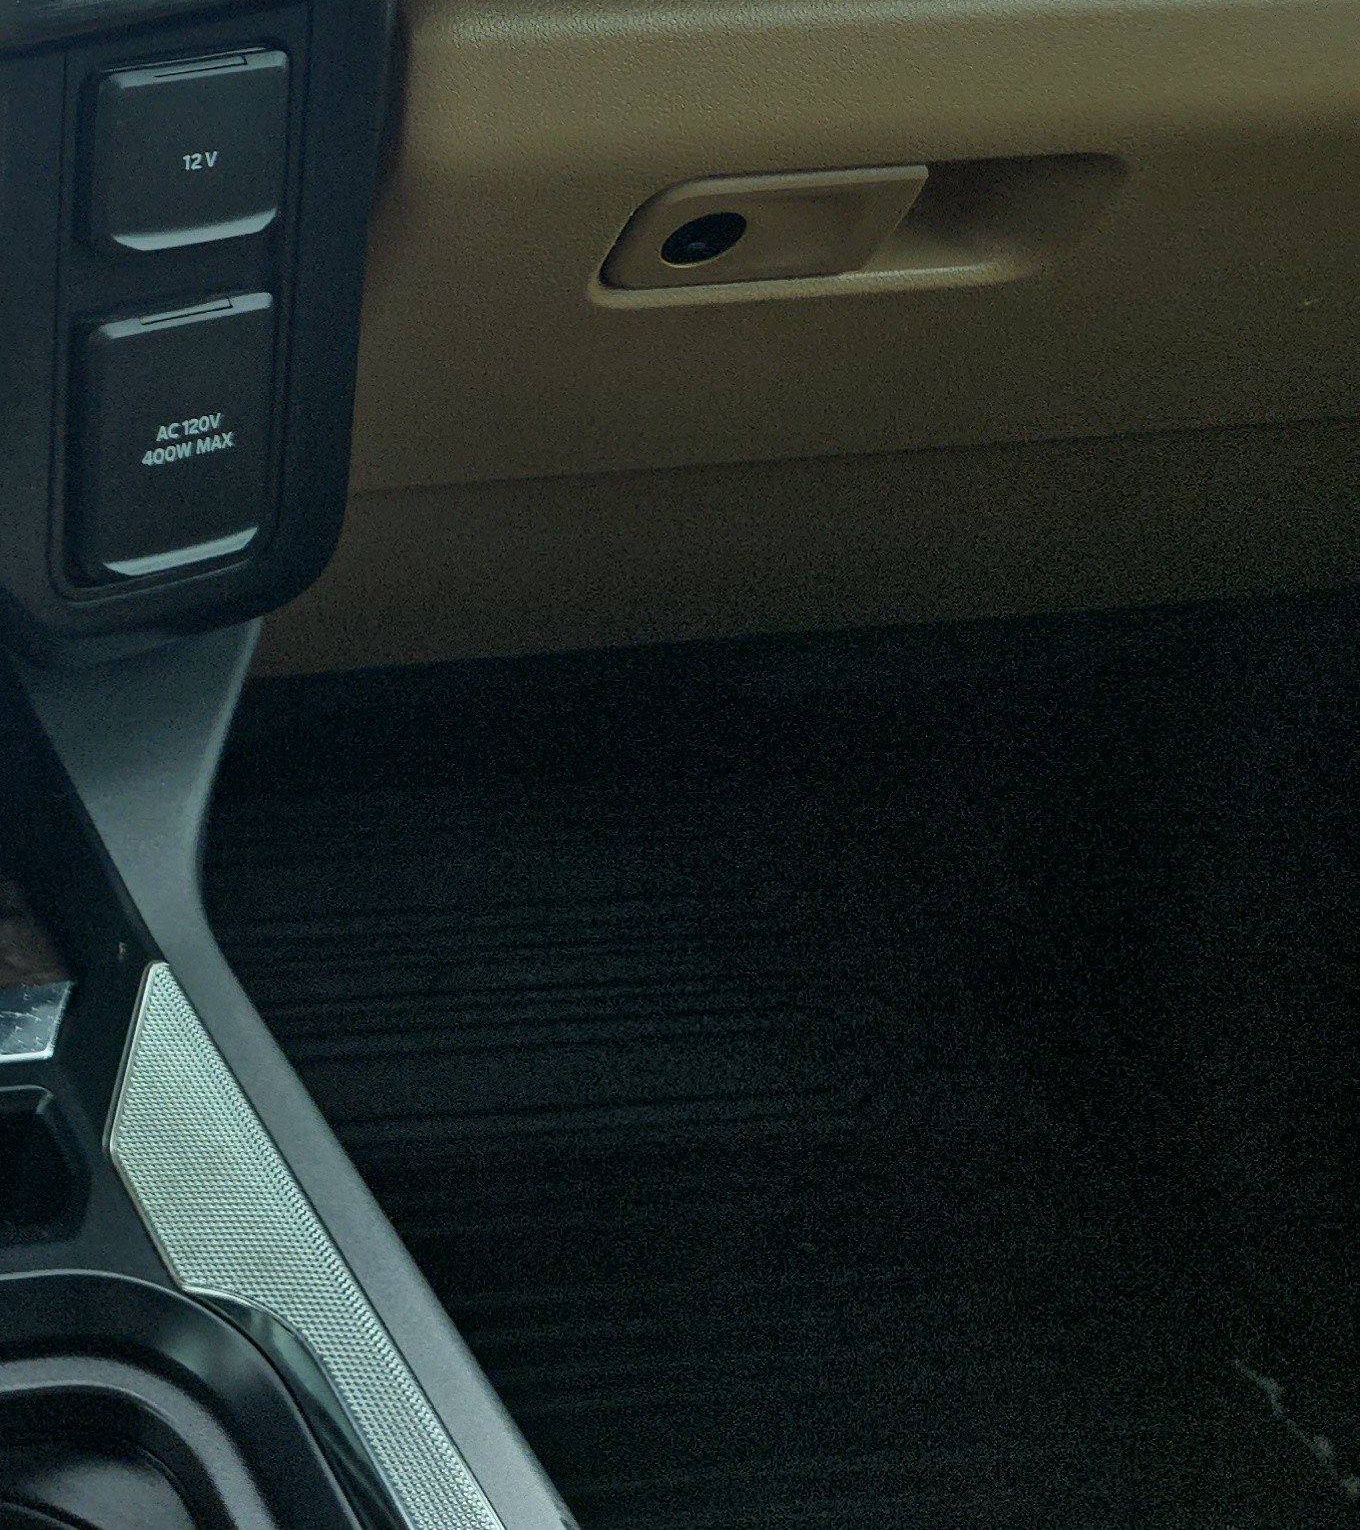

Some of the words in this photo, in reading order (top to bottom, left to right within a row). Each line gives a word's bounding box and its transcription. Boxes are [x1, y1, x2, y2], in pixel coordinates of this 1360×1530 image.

[182, 152, 204, 171] 12
[206, 151, 219, 169] V
[155, 423, 181, 442] AC
[182, 413, 221, 437] 120V
[141, 443, 194, 467] 400W
[196, 431, 234, 455] MAX
